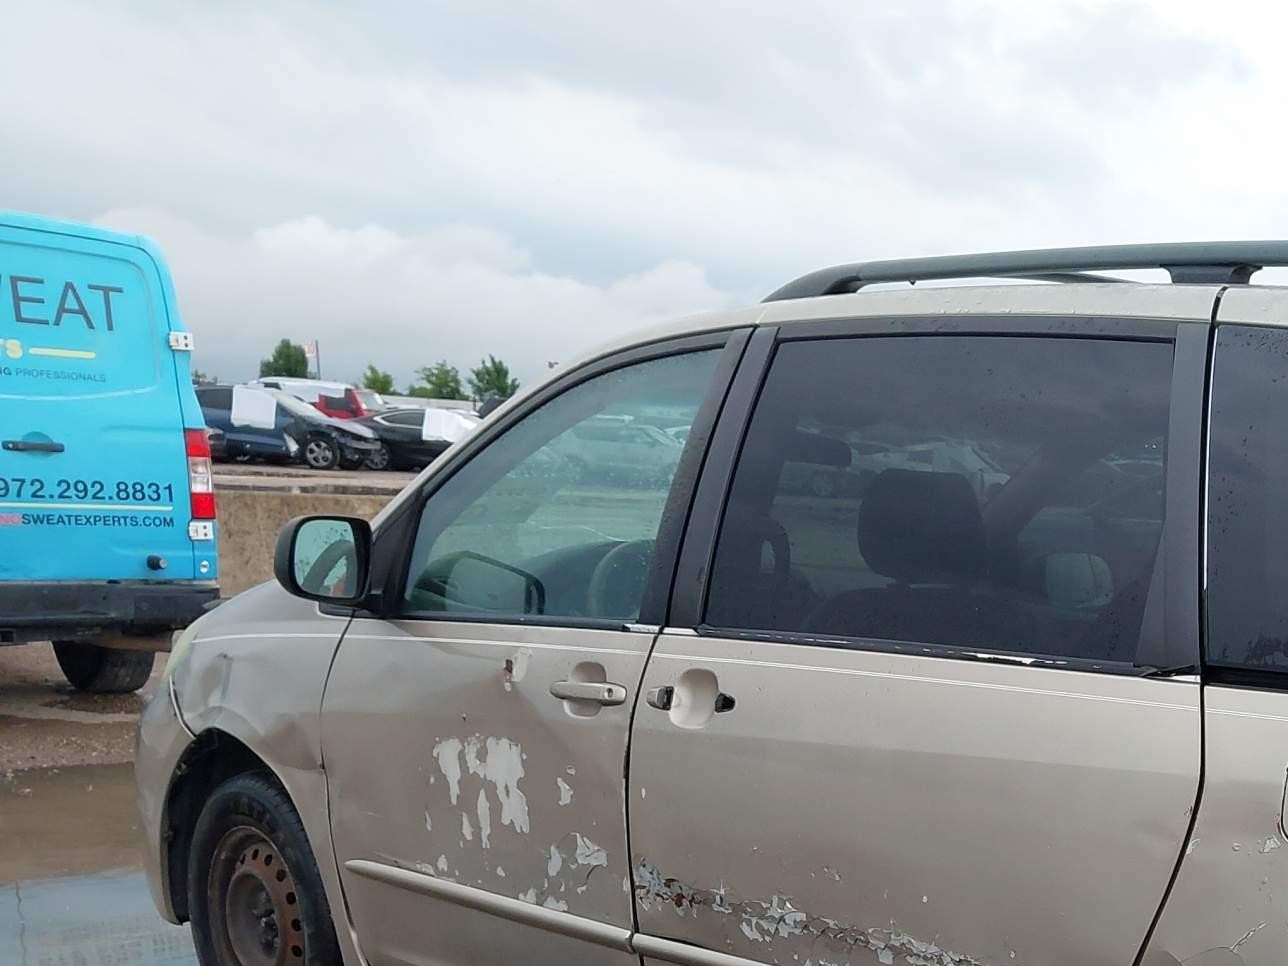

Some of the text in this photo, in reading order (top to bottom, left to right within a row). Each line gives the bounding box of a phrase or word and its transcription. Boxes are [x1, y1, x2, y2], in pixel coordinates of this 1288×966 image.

[0, 273, 124, 331] EAT
[16, 368, 106, 382] PROFESSIONALS
[0, 477, 174, 503] 972.292.8831
